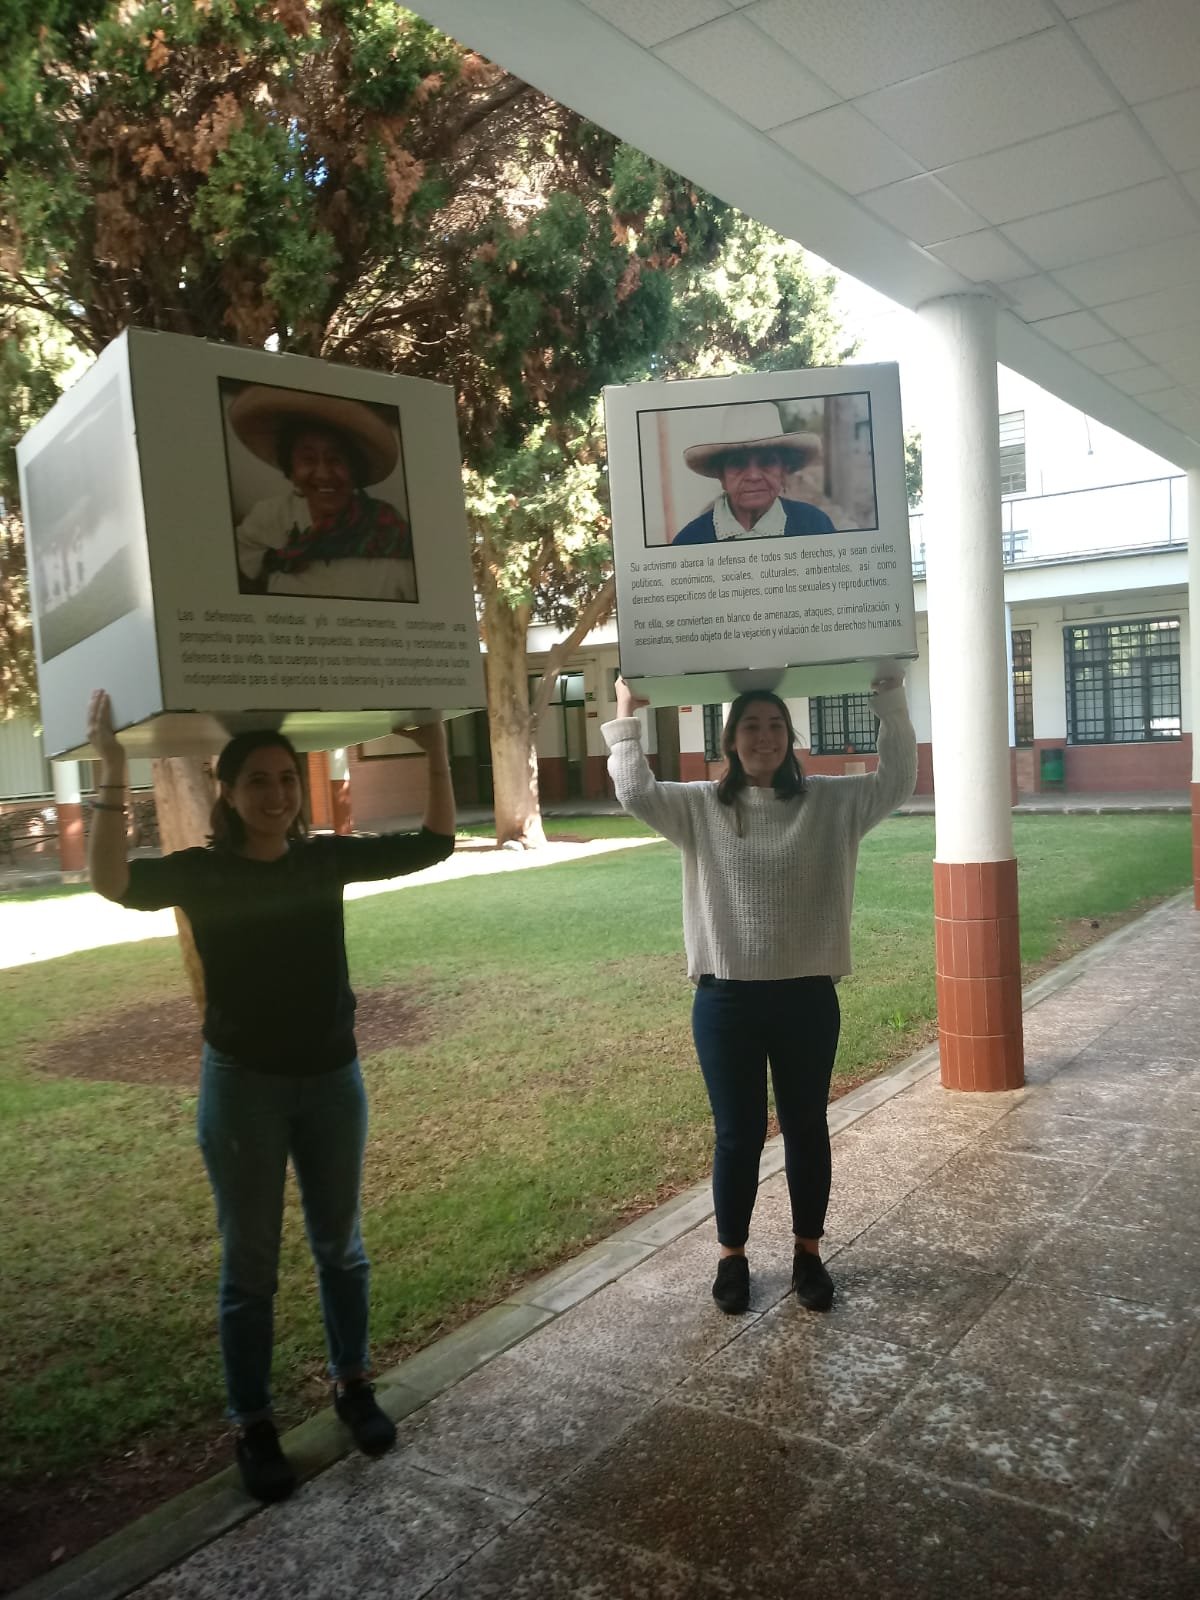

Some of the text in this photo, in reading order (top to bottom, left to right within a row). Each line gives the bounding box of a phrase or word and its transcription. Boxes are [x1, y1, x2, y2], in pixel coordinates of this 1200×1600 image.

[630, 543, 896, 572] Su activismo abarca la defensa de todos sus derechos, ya sean civiles,
[671, 575, 716, 586] económicos,
[760, 567, 799, 579] culturales,
[877, 560, 897, 569] como
[632, 594, 665, 605] derechos
[708, 589, 717, 599] de
[718, 588, 730, 598] las
[731, 585, 763, 599] mujeres,
[764, 586, 784, 595] como
[785, 583, 798, 592] los
[799, 580, 831, 592] sexuales
[634, 619, 646, 629] Por
[648, 618, 664, 628] ello,
[665, 619, 675, 627] se
[677, 615, 714, 627] convierten
[715, 615, 725, 623] en
[727, 612, 751, 622] blanco
[752, 611, 762, 620] de
[764, 609, 802, 621] amenazas,
[804, 606, 835, 619] ataques,
[836, 601, 890, 615] criminalización
[634, 635, 674, 646] asesinatos,
[675, 632, 699, 643] siendo
[700, 630, 722, 643] objeto
[723, 630, 732, 639] de
[733, 629, 741, 638] la
[742, 626, 771, 640] vejación
[778, 624, 809, 636] violación
[810, 623, 820, 633] de
[821, 622, 833, 632] los
[834, 620, 867, 631] derechos
